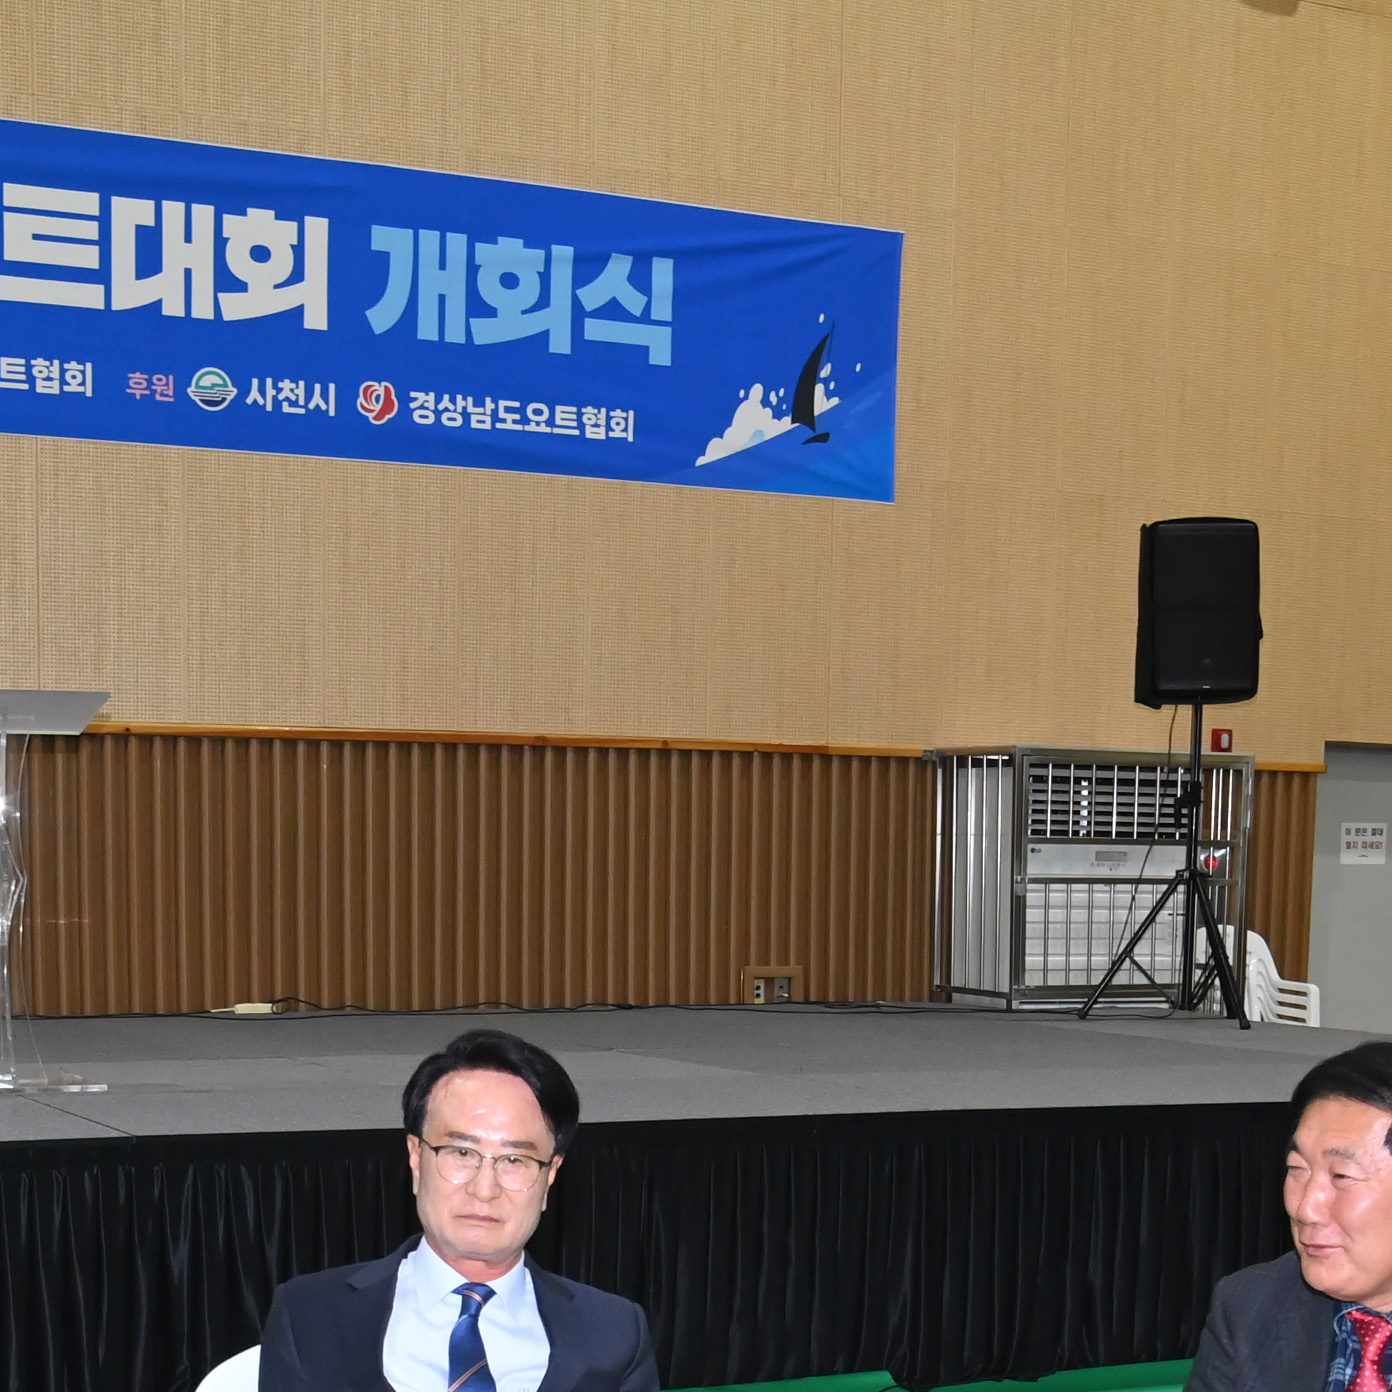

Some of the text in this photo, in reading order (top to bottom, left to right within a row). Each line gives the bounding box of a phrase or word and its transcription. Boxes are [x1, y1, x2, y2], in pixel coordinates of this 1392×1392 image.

[364, 223, 675, 366] 개회식
[125, 371, 635, 443] 후원 사천시 경상남도요트협회
